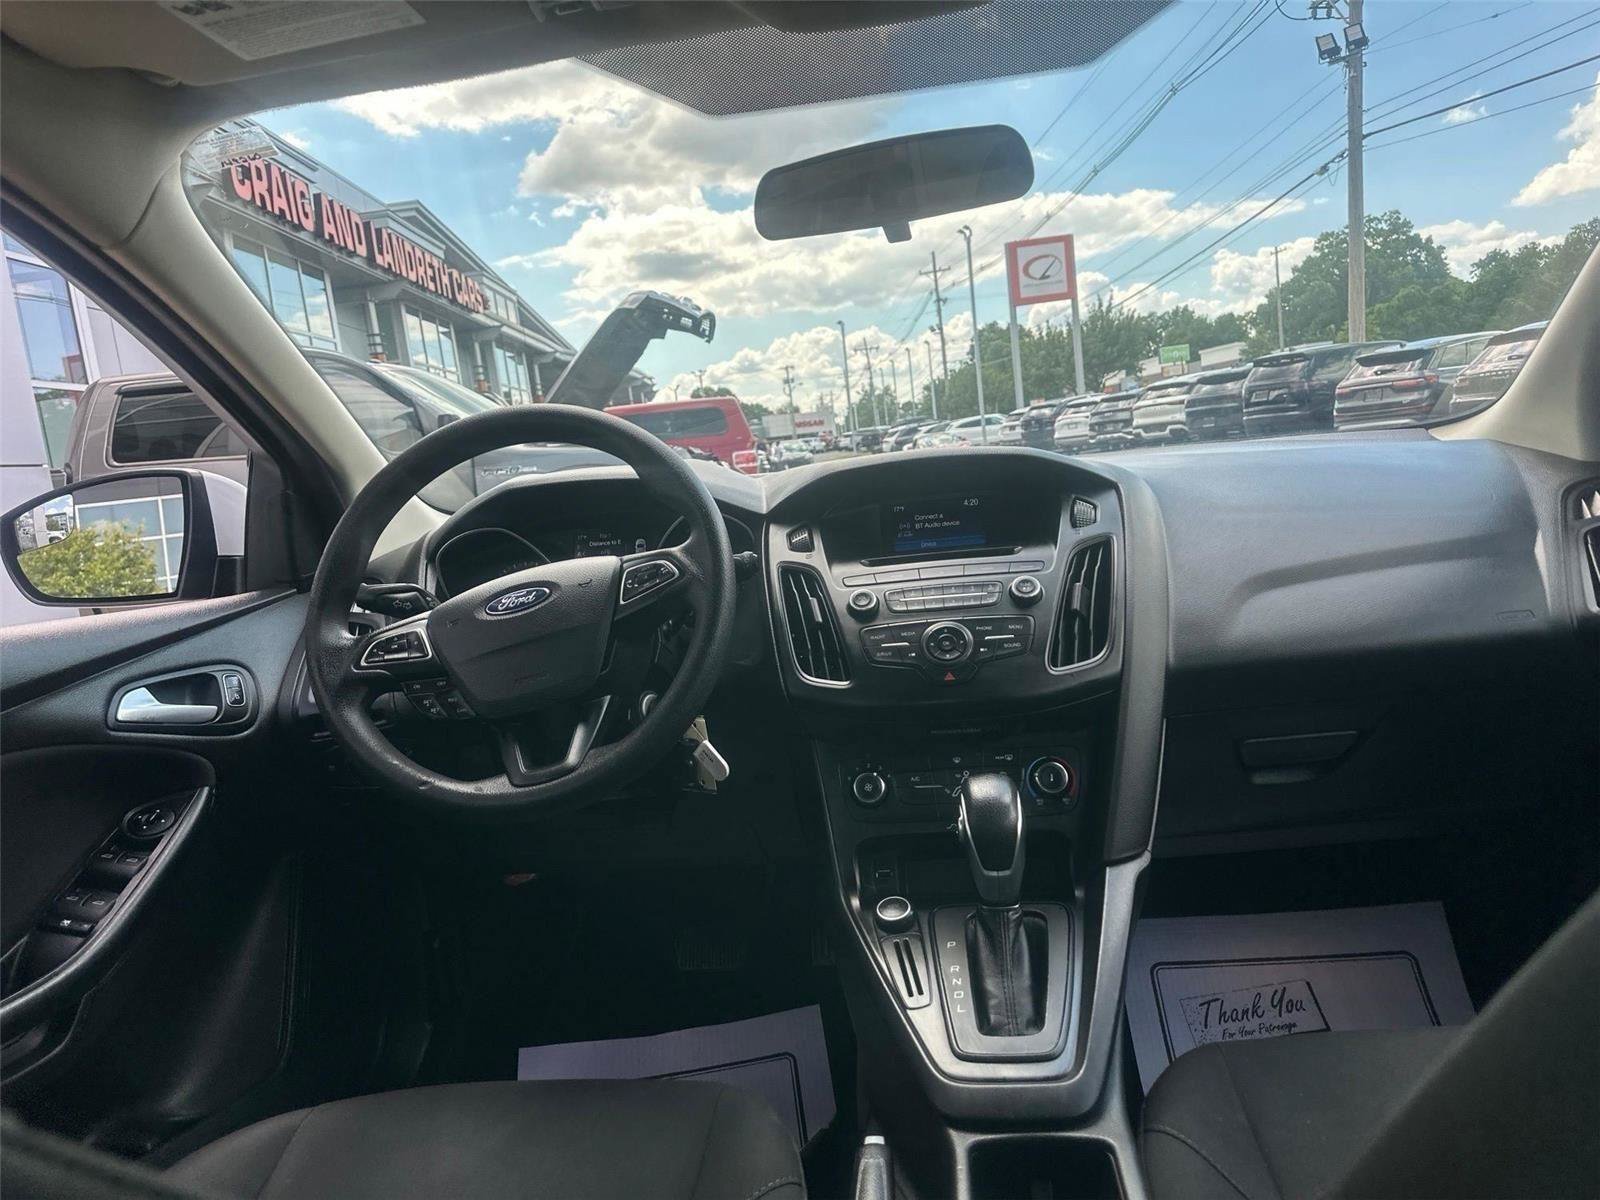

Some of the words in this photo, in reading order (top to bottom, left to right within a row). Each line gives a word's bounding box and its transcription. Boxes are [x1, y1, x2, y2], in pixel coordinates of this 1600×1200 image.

[230, 158, 315, 232] CRAIG
[321, 193, 367, 257] AND
[371, 220, 452, 299] LANDRETH
[452, 270, 485, 313] CARS
[963, 497, 979, 506] 4:20
[914, 513, 939, 521] Connect
[915, 522, 923, 530] BT
[498, 590, 537, 611] Ford
[947, 941, 956, 949] P
[950, 965, 961, 973] R
[952, 977, 962, 985] N
[954, 990, 964, 999] D
[957, 1004, 967, 1012] L
[1199, 992, 1266, 1029] Thank
[1271, 987, 1306, 1018] You
[1222, 1028, 1237, 1040] For
[1238, 1025, 1256, 1038] Your
[1258, 1021, 1299, 1034] Patronage
